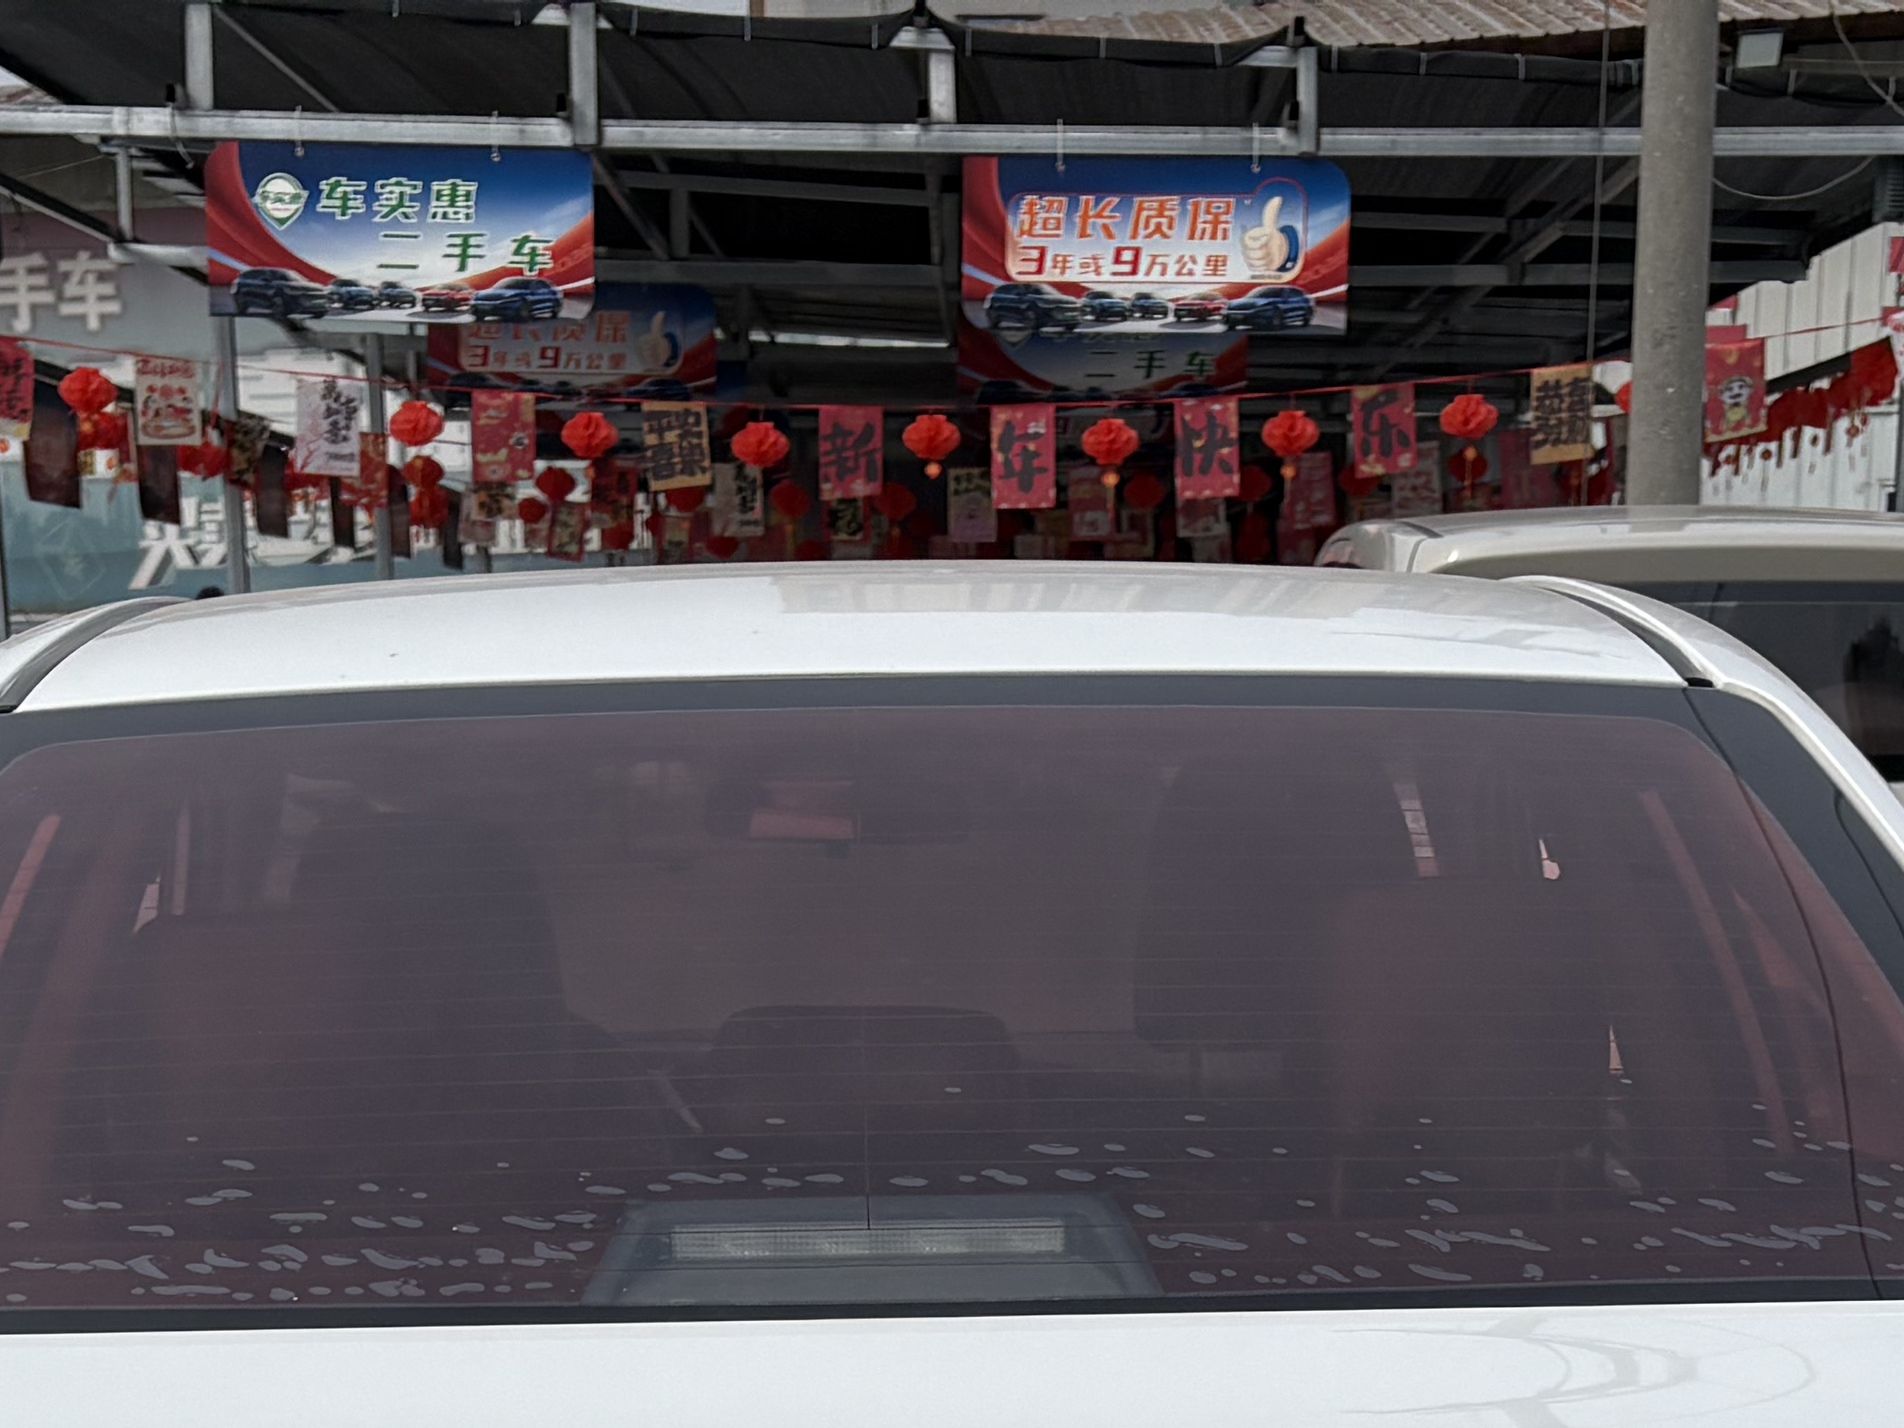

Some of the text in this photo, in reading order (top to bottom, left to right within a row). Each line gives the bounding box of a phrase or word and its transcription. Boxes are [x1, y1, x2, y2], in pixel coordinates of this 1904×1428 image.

[316, 177, 478, 222] 车实惠
[1018, 195, 1235, 241] 超长质保
[377, 233, 554, 276] 二手车
[1016, 245, 1228, 276] 3年或9万公里
